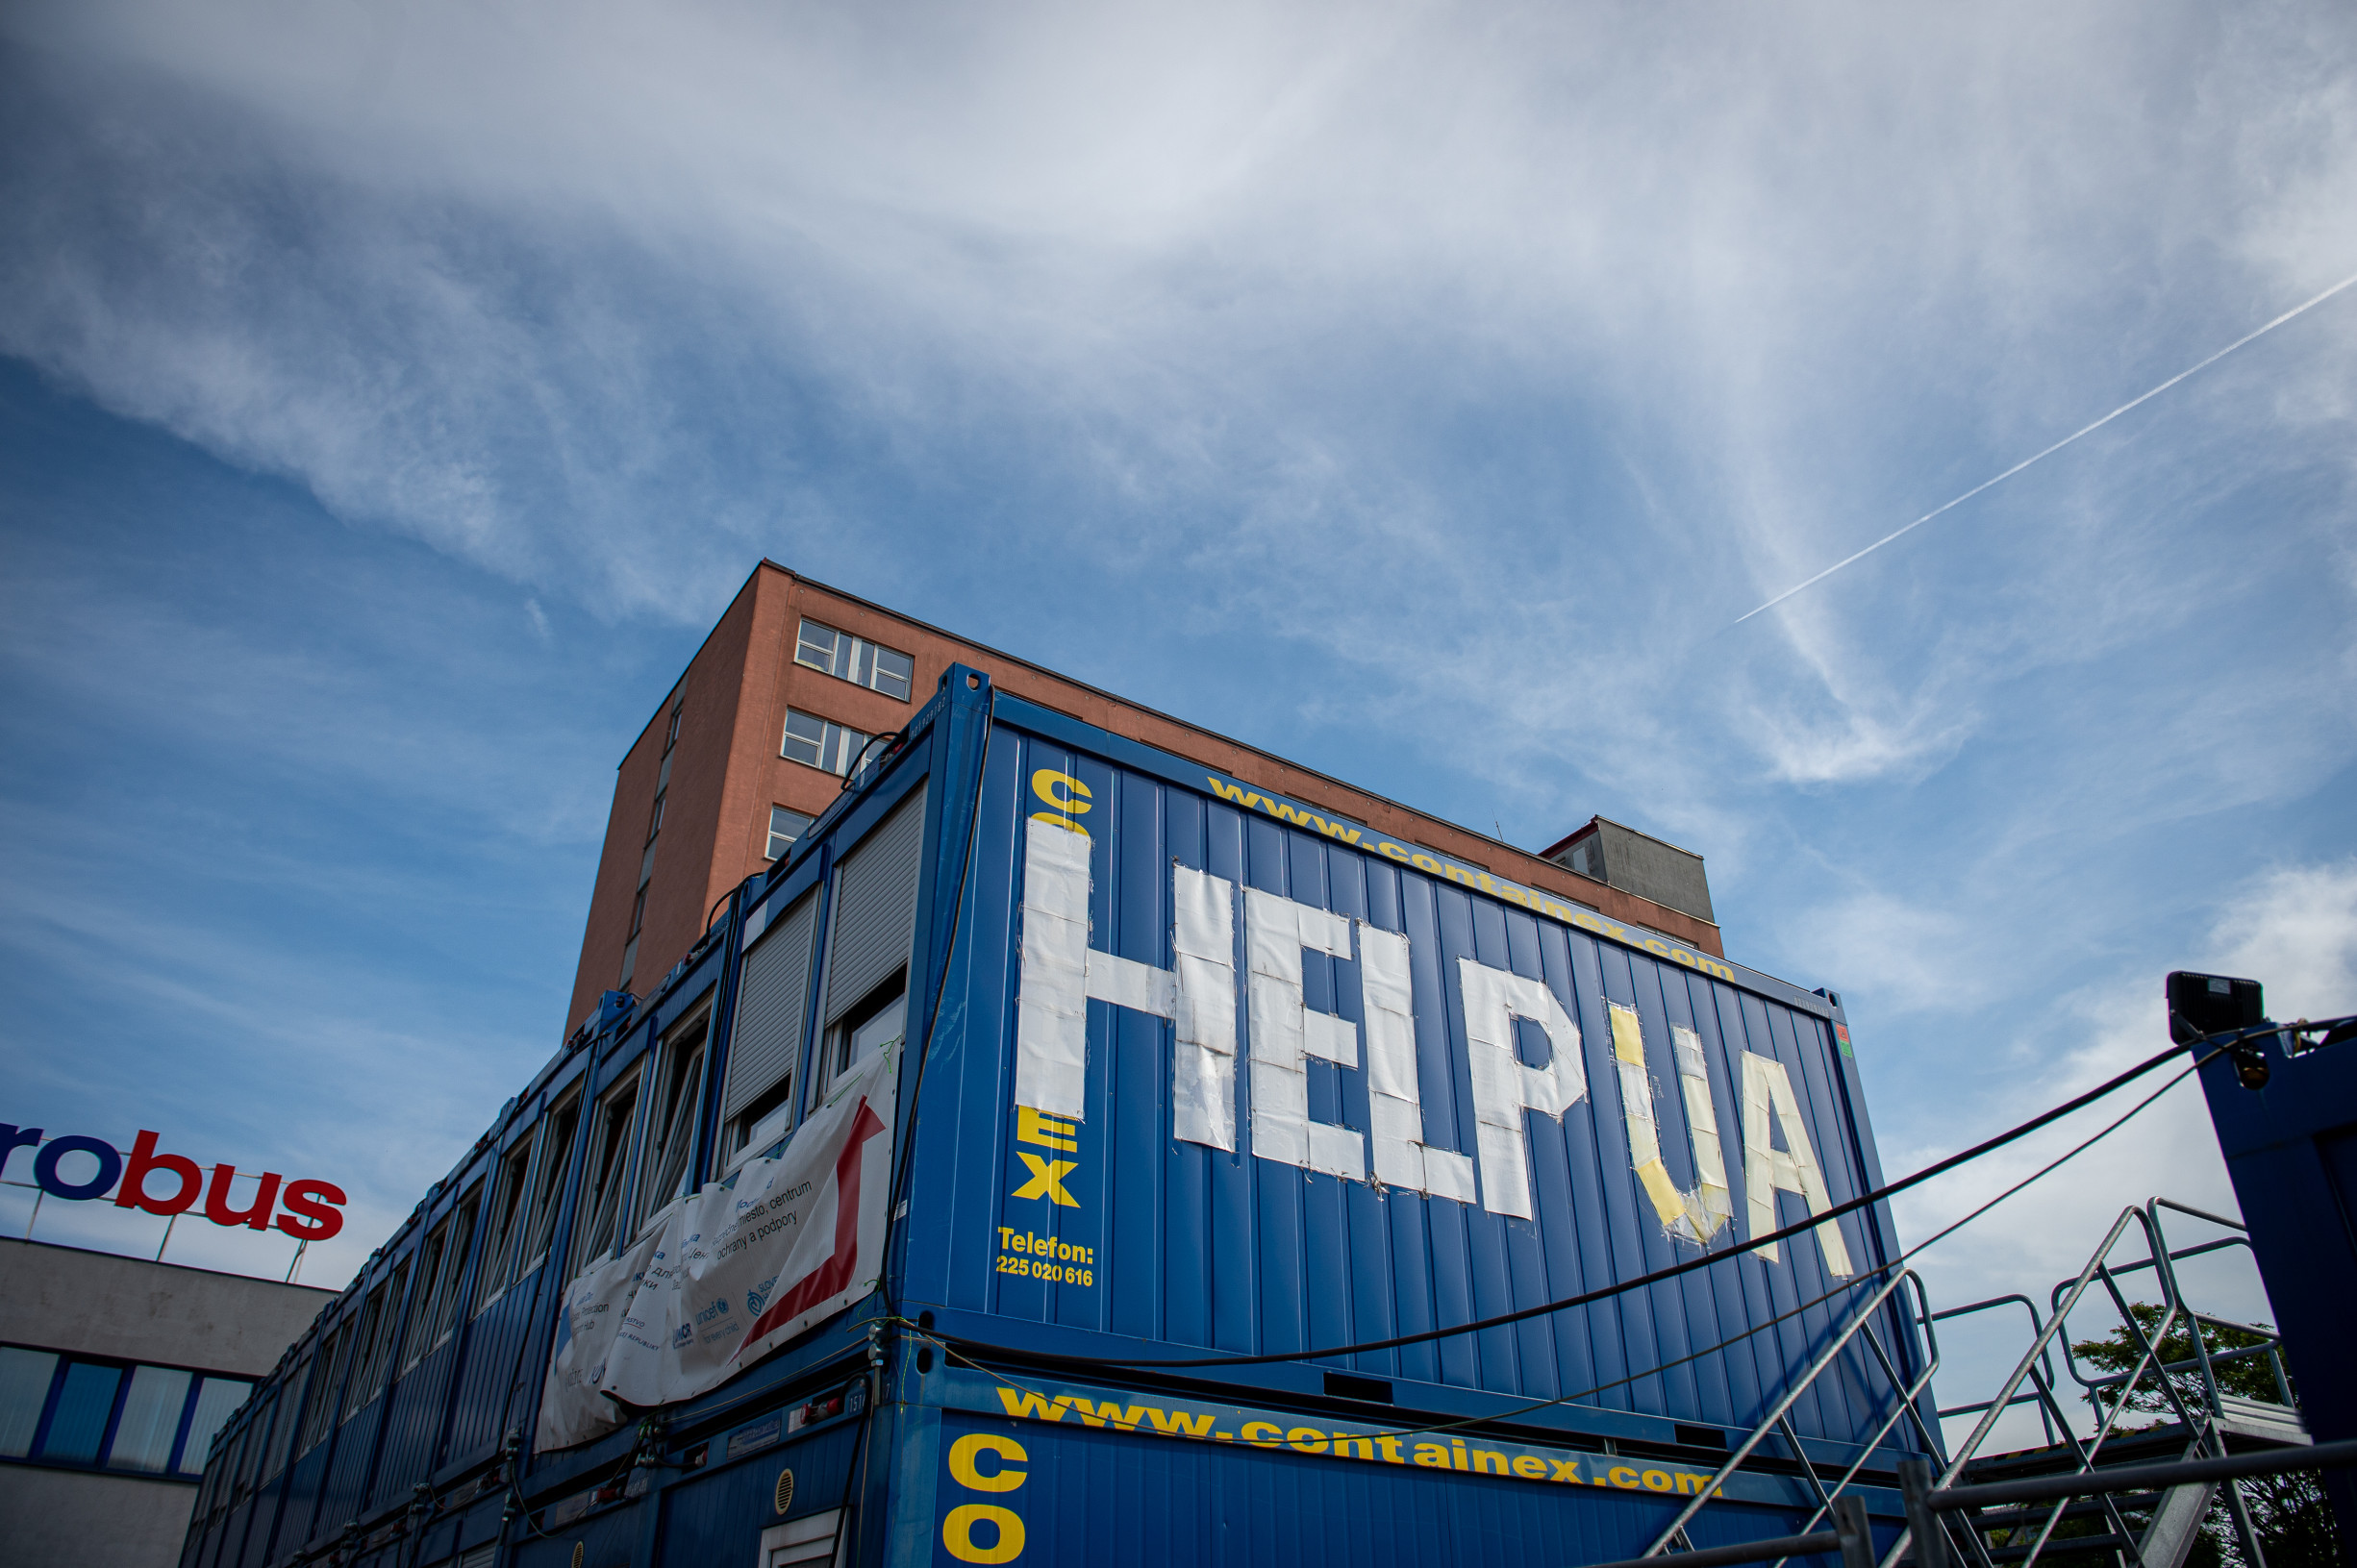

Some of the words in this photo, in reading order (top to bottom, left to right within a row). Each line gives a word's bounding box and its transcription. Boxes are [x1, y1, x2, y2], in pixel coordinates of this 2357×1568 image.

[1208, 777, 1736, 983] www.containex.com
[1015, 815, 1587, 1222] HELP
[1604, 997, 1854, 1281] UA
[0, 1122, 347, 1241] robus
[738, 1203, 769, 1228] miesto,
[769, 1181, 814, 1210] centrum
[716, 1233, 748, 1260] ochrany
[749, 1232, 757, 1242] a
[757, 1209, 798, 1241] podpory
[996, 1256, 1029, 1277] 225
[1032, 1260, 1063, 1282] 020
[1066, 1266, 1093, 1287] 616
[997, 1227, 1093, 1265] Telefon:
[694, 1301, 719, 1326] unicef
[996, 1387, 1724, 1497] www.containex.com
[943, 1434, 1029, 1566] CO
